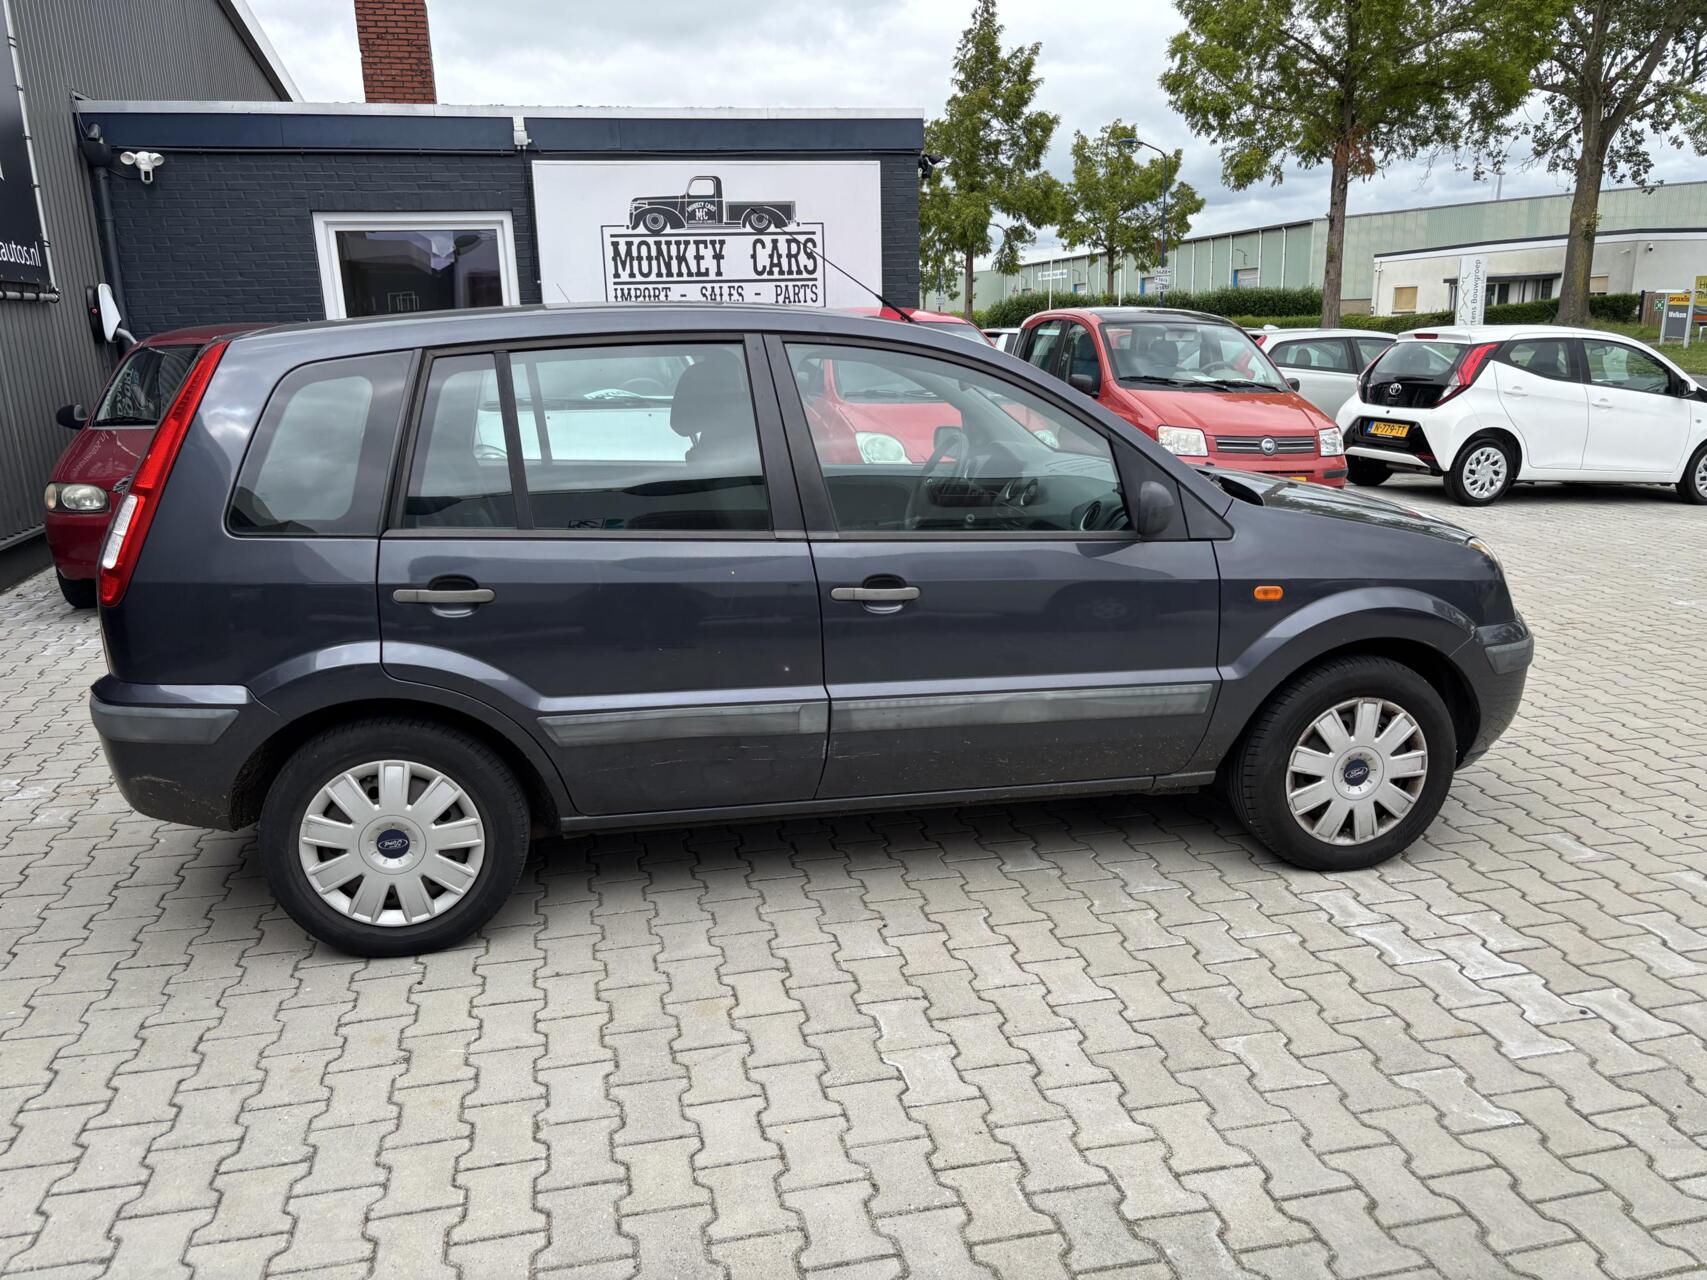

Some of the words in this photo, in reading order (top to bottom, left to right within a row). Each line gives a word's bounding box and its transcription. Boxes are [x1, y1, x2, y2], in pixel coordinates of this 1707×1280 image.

[695, 208, 708, 220] MC
[0, 240, 41, 267] autos.nl
[611, 239, 726, 279] MONKEY
[751, 237, 818, 276] CARS
[613, 287, 671, 301] IMPORT
[700, 285, 744, 302] SALES
[775, 284, 818, 304] PARTS
